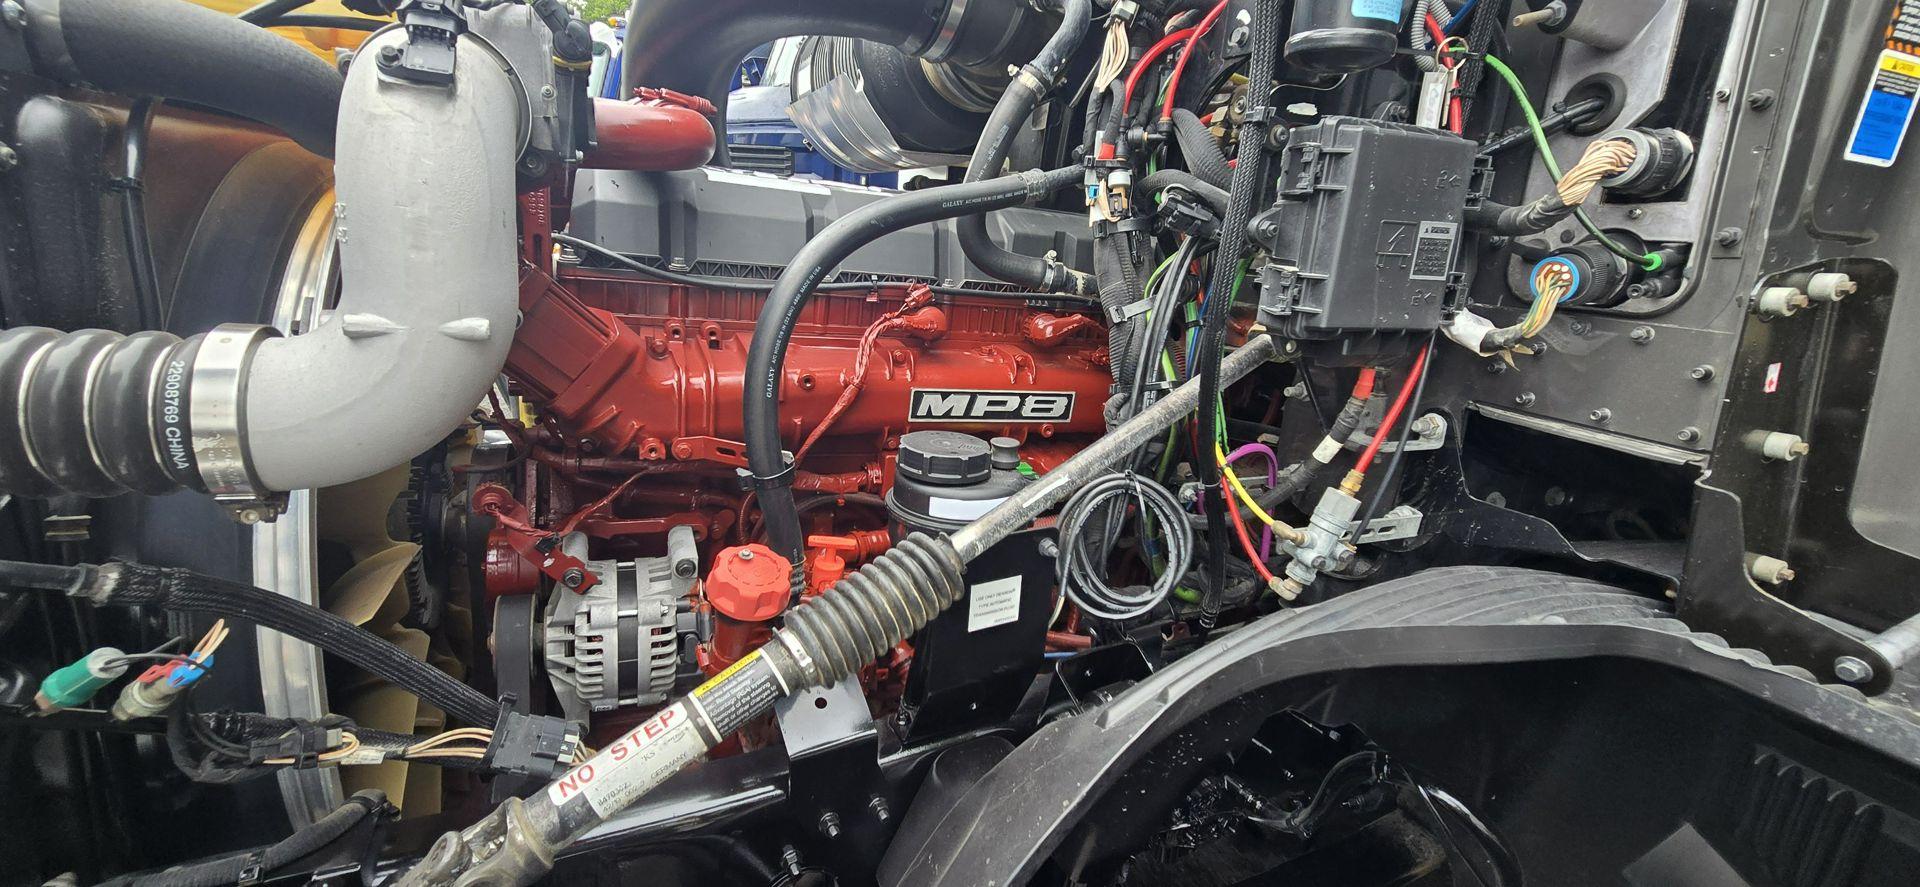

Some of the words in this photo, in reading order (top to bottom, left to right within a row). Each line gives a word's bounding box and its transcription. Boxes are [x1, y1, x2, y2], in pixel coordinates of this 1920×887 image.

[164, 360, 185, 424] 22908769
[766, 367, 775, 398] GALAXY
[916, 392, 1069, 418] MP8
[166, 427, 190, 470] CHINA
[709, 696, 737, 717] Advantage
[711, 704, 736, 723] Removal
[740, 694, 751, 704] the
[749, 681, 771, 697] steering
[735, 703, 750, 715] other
[749, 689, 771, 706] changes
[558, 764, 595, 798] NO
[610, 710, 674, 762] STEP
[650, 752, 688, 780] GERMANY
